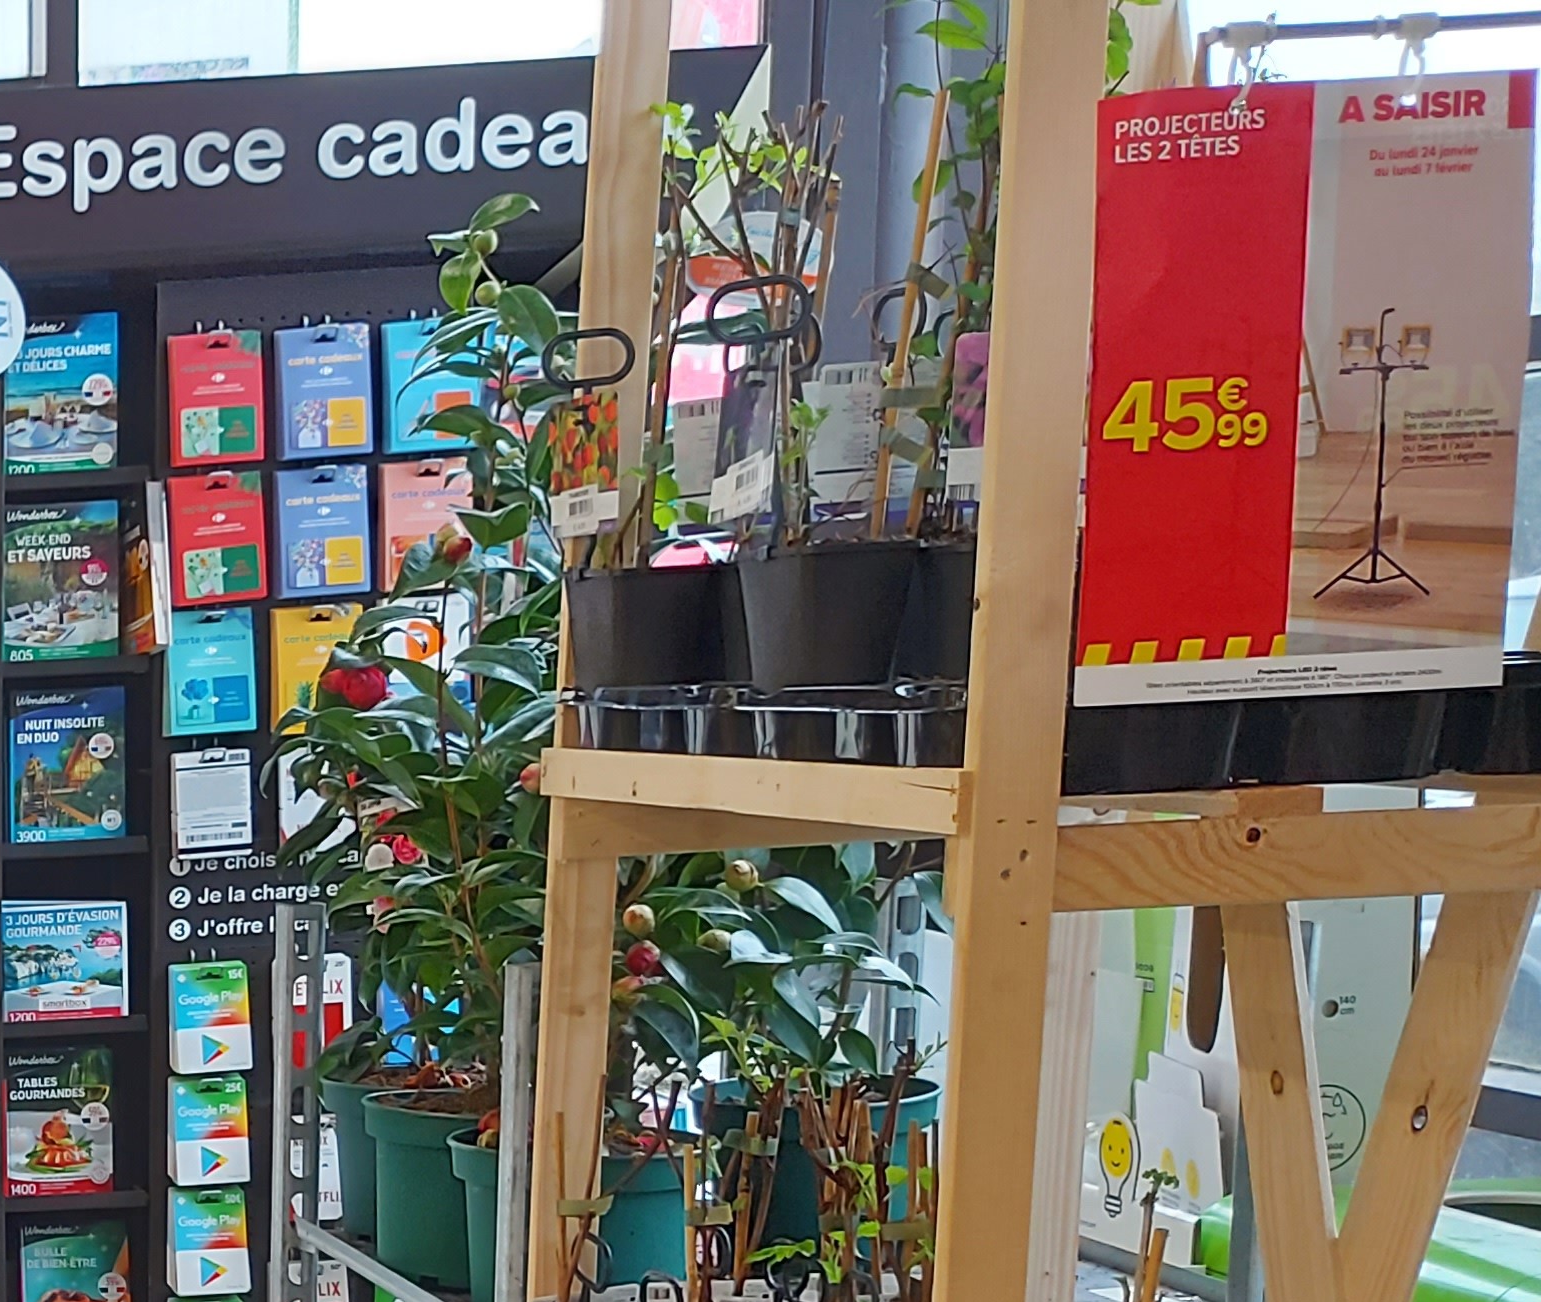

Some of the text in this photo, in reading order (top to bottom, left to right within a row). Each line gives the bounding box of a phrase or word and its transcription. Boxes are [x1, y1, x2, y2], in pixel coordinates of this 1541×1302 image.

[1339, 89, 1487, 124] A SAISIR
[1115, 109, 1266, 140] PROJECTEURS
[317, 96, 588, 179] cadea
[1114, 134, 1241, 163] LES 2 TÊTES
[1369, 144, 1479, 161] Du lundi 24 janvier
[1373, 166, 1389, 178] au
[1392, 163, 1422, 177] lundi
[1425, 162, 1433, 174] 7
[24, 343, 112, 359] JOURS CHARME
[22, 359, 68, 372] DÉLICES
[287, 352, 363, 367] carte cadeaux
[285, 491, 361, 507] carte cadeaux
[16, 533, 72, 547] WEEK-END
[7, 546, 92, 563] ET SAVEURS
[9, 650, 34, 662] 805
[25, 716, 105, 731] NUIT INSOLITE
[17, 731, 59, 744] EN DUO
[16, 830, 46, 842] 3900
[197, 884, 320, 905] Je la charge
[5, 908, 119, 926] 3 JOURS D'ÉVASION
[6, 924, 83, 939] GOURMANDE
[197, 918, 263, 937] J'offre
[42, 999, 88, 1009] smartbox
[178, 990, 243, 1006] Google Play
[17, 1077, 58, 1088] TABLES
[9, 1086, 86, 1101] GOURMANDES
[177, 1103, 241, 1118] Google Play
[10, 1184, 37, 1196] 1400
[178, 1214, 240, 1228] Google Play
[34, 1247, 68, 1257] BULLE
[27, 1257, 97, 1268] DE BIEN-ÊTRE
